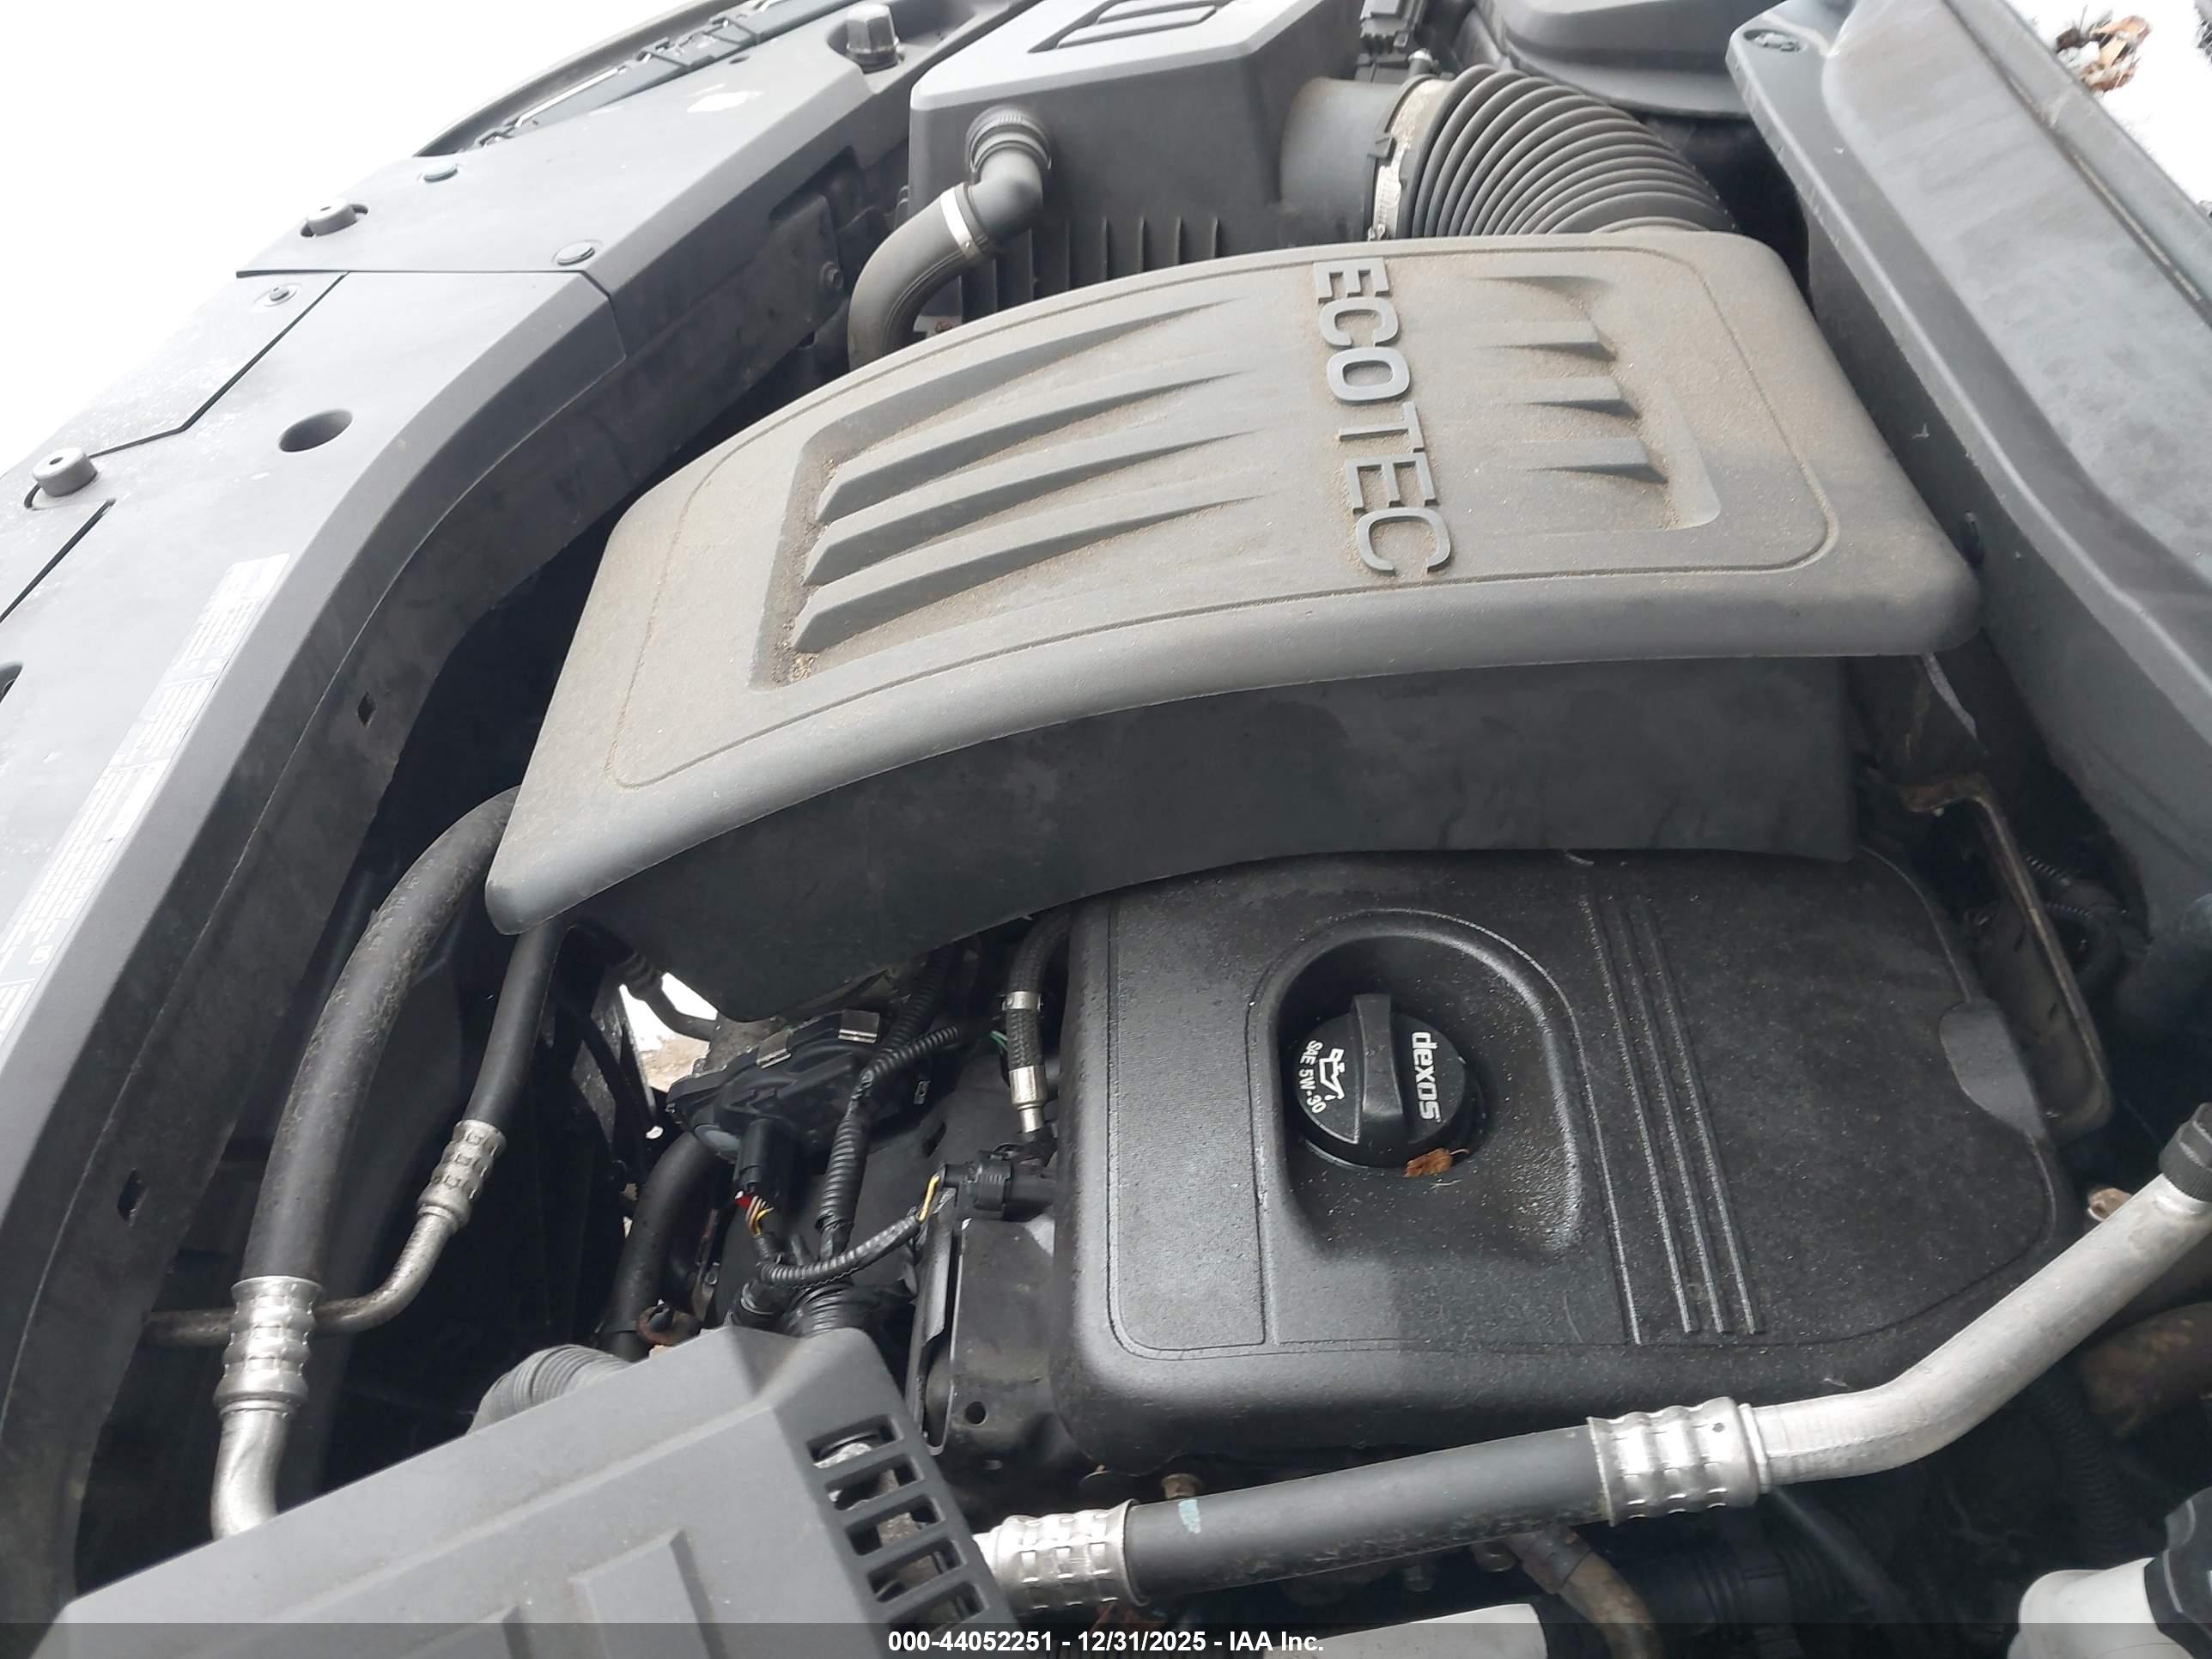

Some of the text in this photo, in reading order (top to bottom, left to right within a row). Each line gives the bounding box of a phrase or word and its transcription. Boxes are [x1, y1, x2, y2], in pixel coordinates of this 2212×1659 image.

[1314, 258, 1451, 574] ECOTEC
[1298, 1040, 1327, 1114] SAE 5W-30
[1412, 1031, 1441, 1121] dexos
